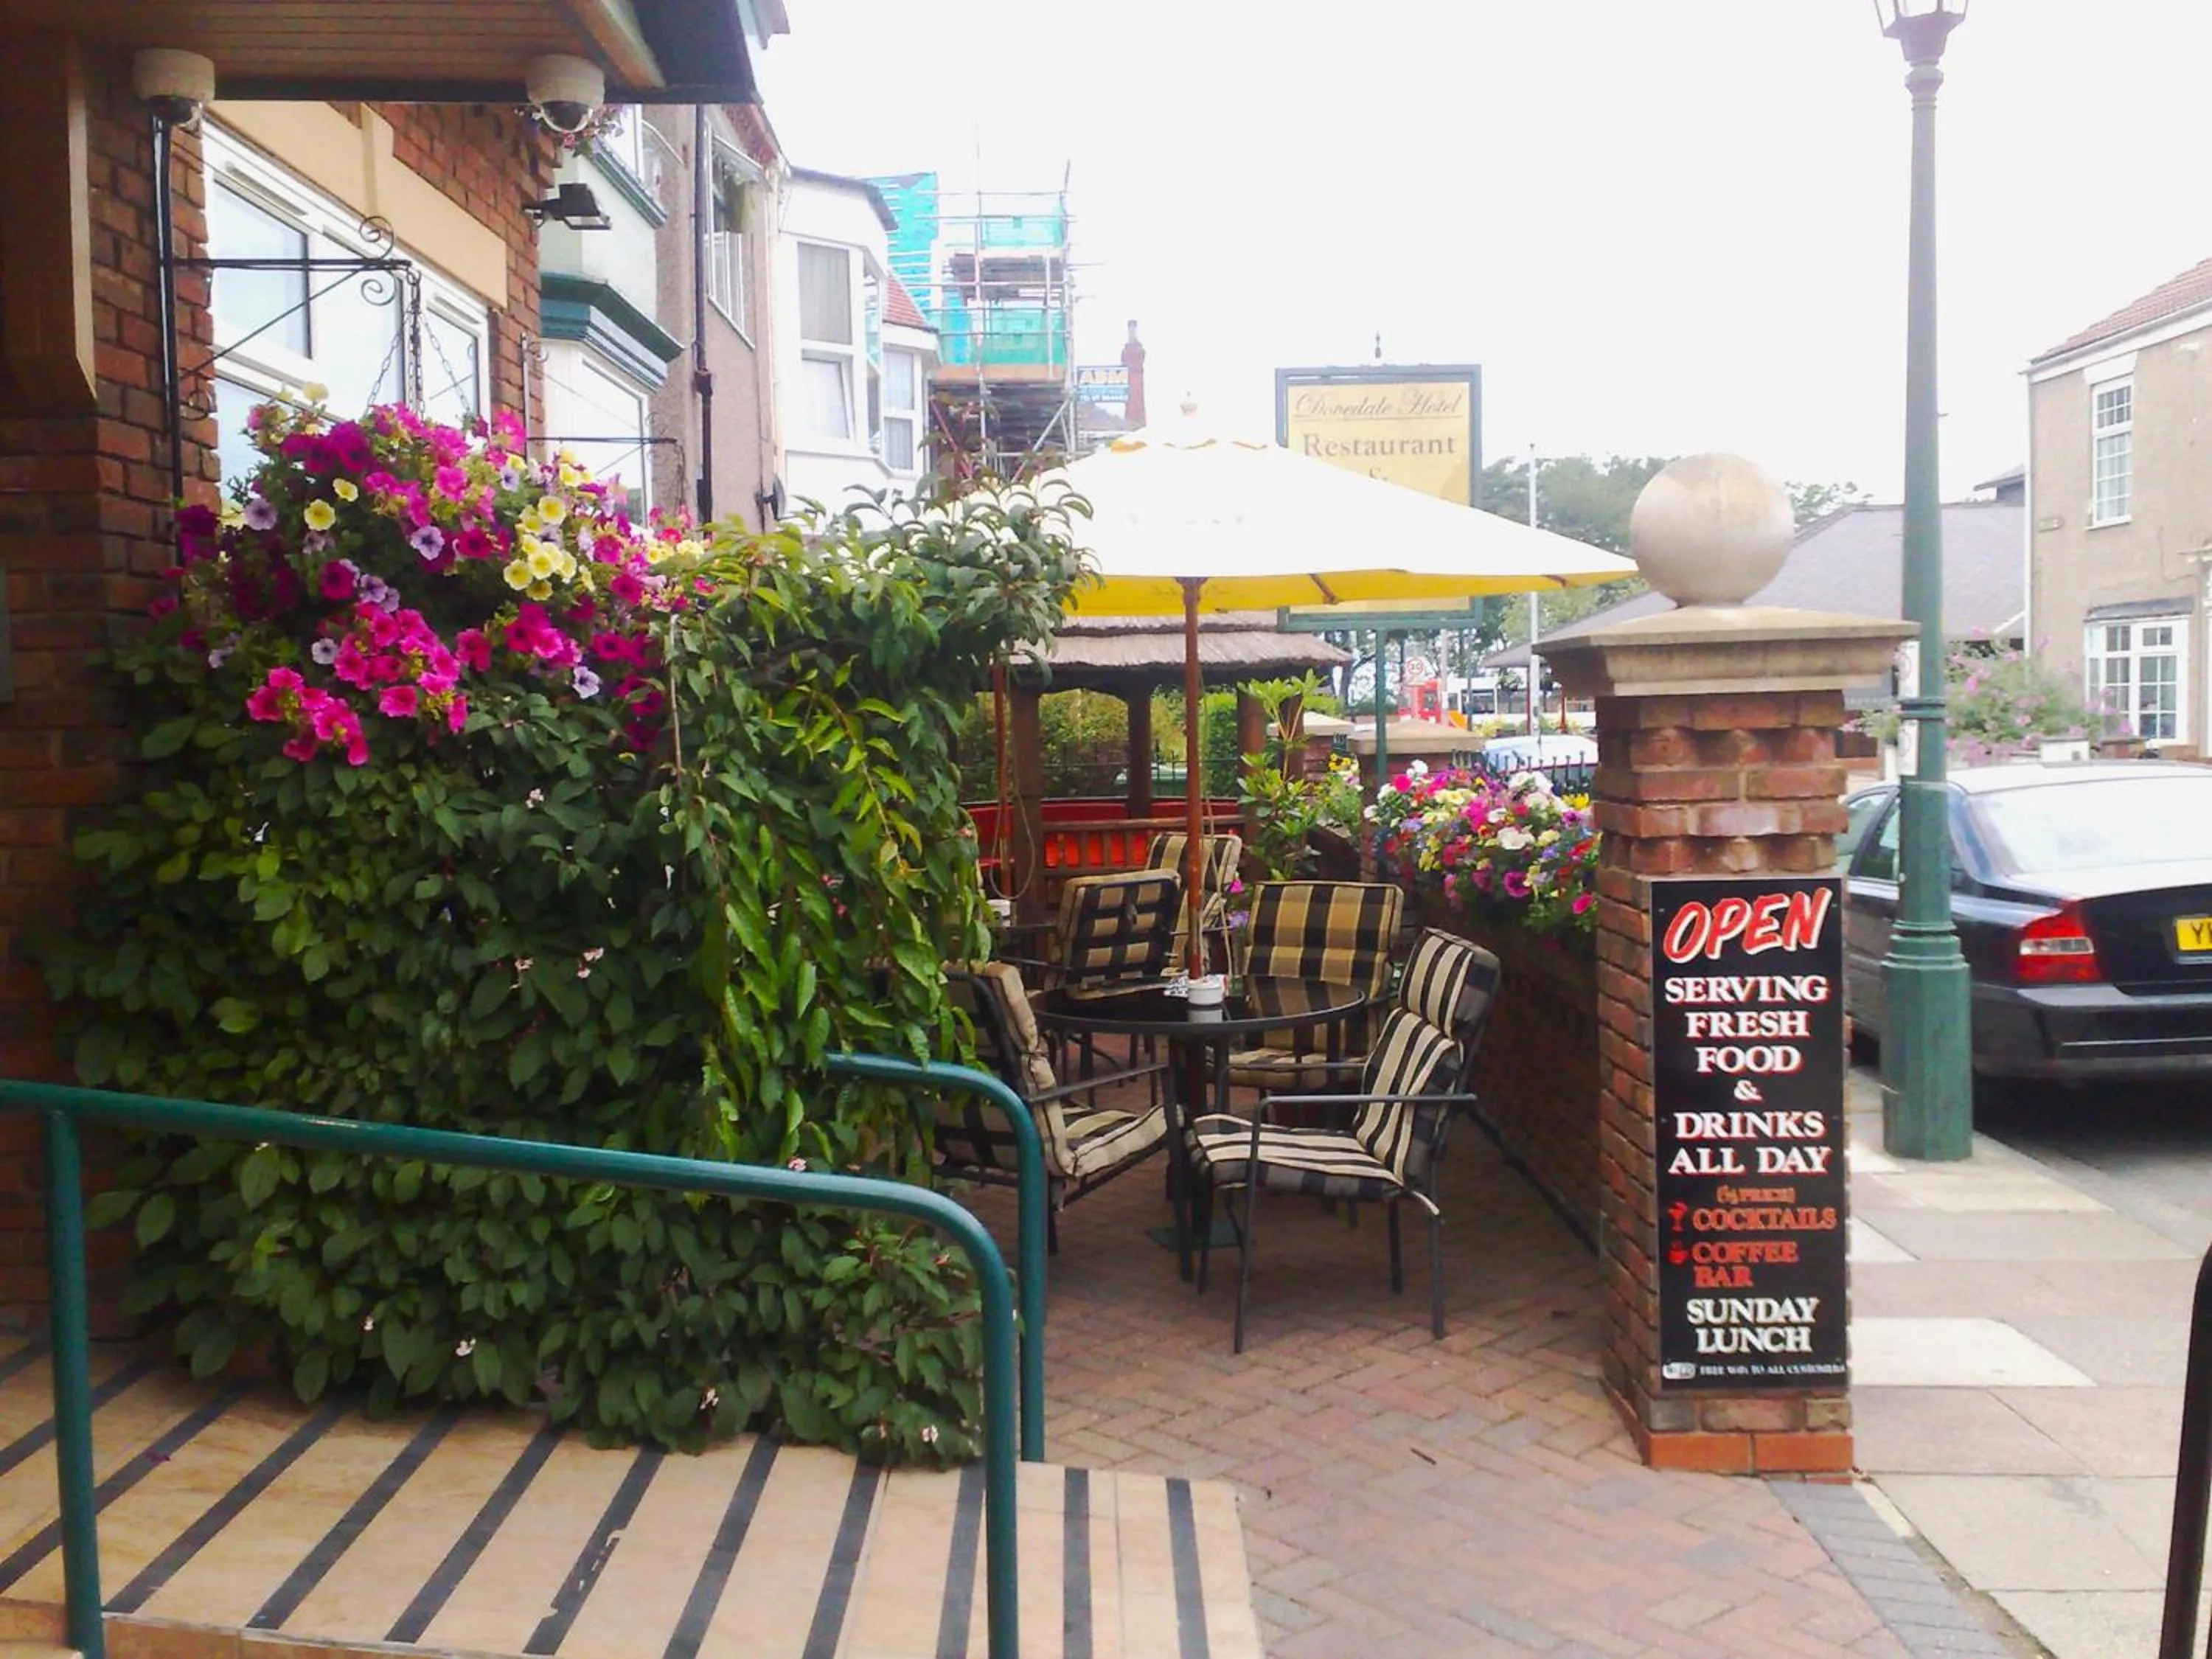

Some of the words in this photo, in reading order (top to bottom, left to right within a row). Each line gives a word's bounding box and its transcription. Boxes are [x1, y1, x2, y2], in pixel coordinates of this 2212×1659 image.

[1397, 389, 1462, 414] Hotel
[1303, 432, 1458, 457] Restaurant
[1663, 887, 1832, 963] OPEN
[1664, 975, 1830, 1004] SERVING
[1685, 1011, 1810, 1038] FRESH
[1695, 1046, 1803, 1074] FOOD
[1733, 1079, 1763, 1101] &
[1674, 1111, 1826, 1139] DRINKS
[1668, 1147, 1746, 1175] ALL
[1756, 1146, 1832, 1174] DAY
[1692, 1207, 1837, 1230] COCKTAILS
[1691, 1241, 1798, 1264] COFFEE
[1693, 1265, 1753, 1288] BAR
[1686, 1297, 1819, 1324] SUNDAY
[1695, 1326, 1812, 1354] LUNCH
